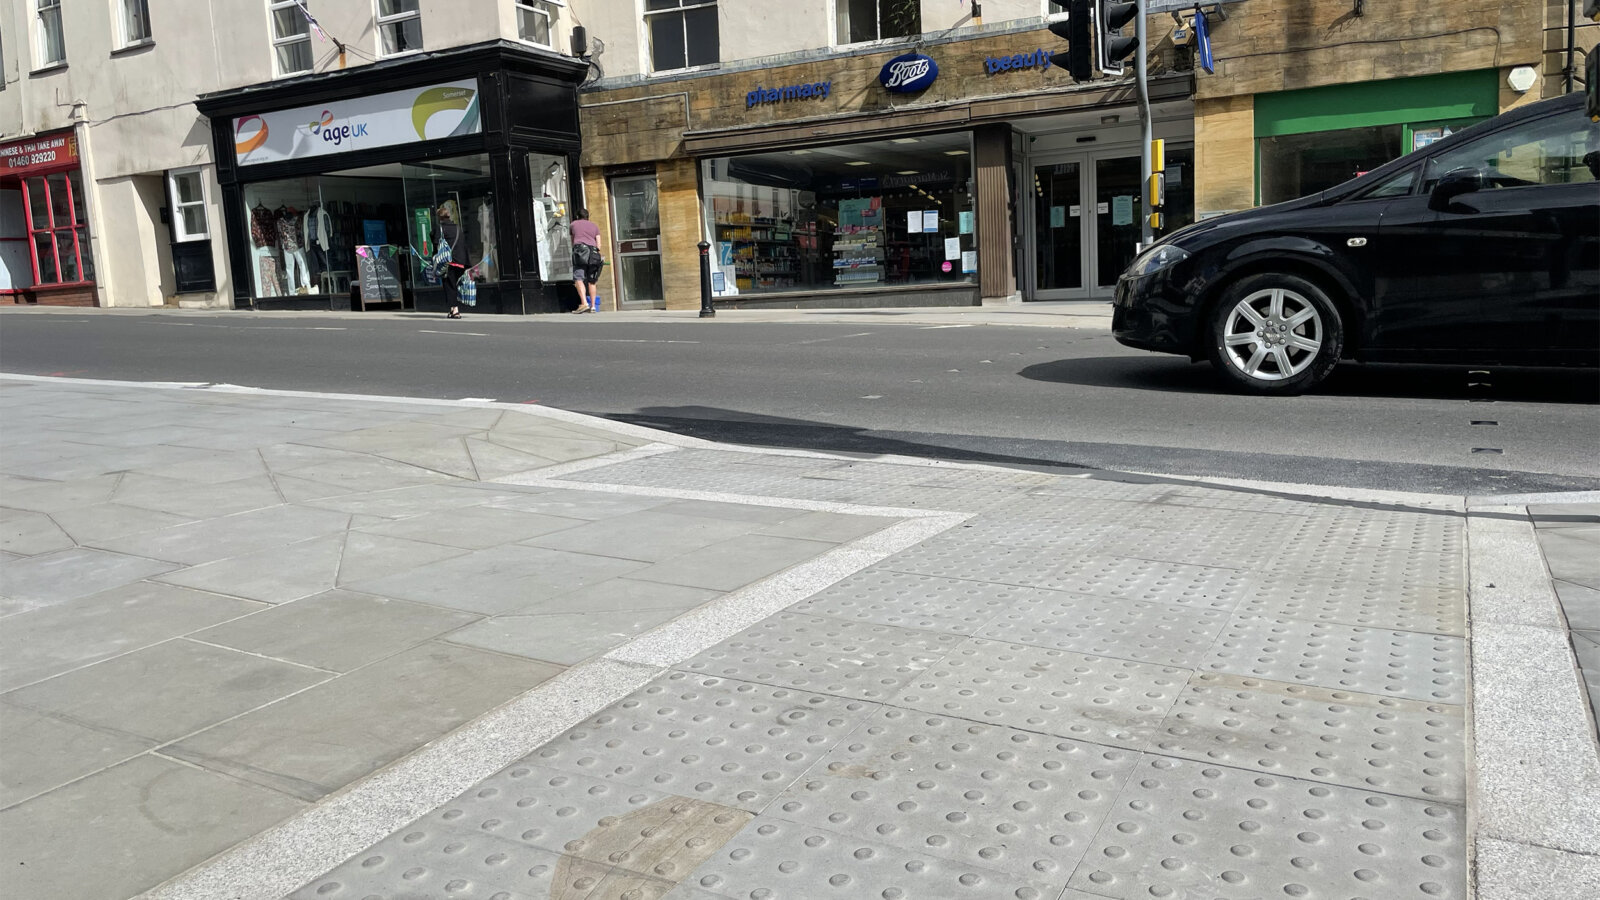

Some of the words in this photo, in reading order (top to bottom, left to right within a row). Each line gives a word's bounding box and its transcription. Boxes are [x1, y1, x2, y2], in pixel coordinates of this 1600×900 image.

[986, 48, 1054, 73] beauty
[885, 59, 929, 87] Boots
[747, 81, 831, 108] pharmacy
[323, 126, 350, 145] age
[351, 123, 368, 137] UK
[24, 143, 36, 153] THAI
[37, 141, 50, 151] TAKE
[51, 138, 65, 148] AWAY
[9, 155, 29, 168] 01460
[31, 151, 56, 164] 929220
[366, 265, 388, 273] OPEN
